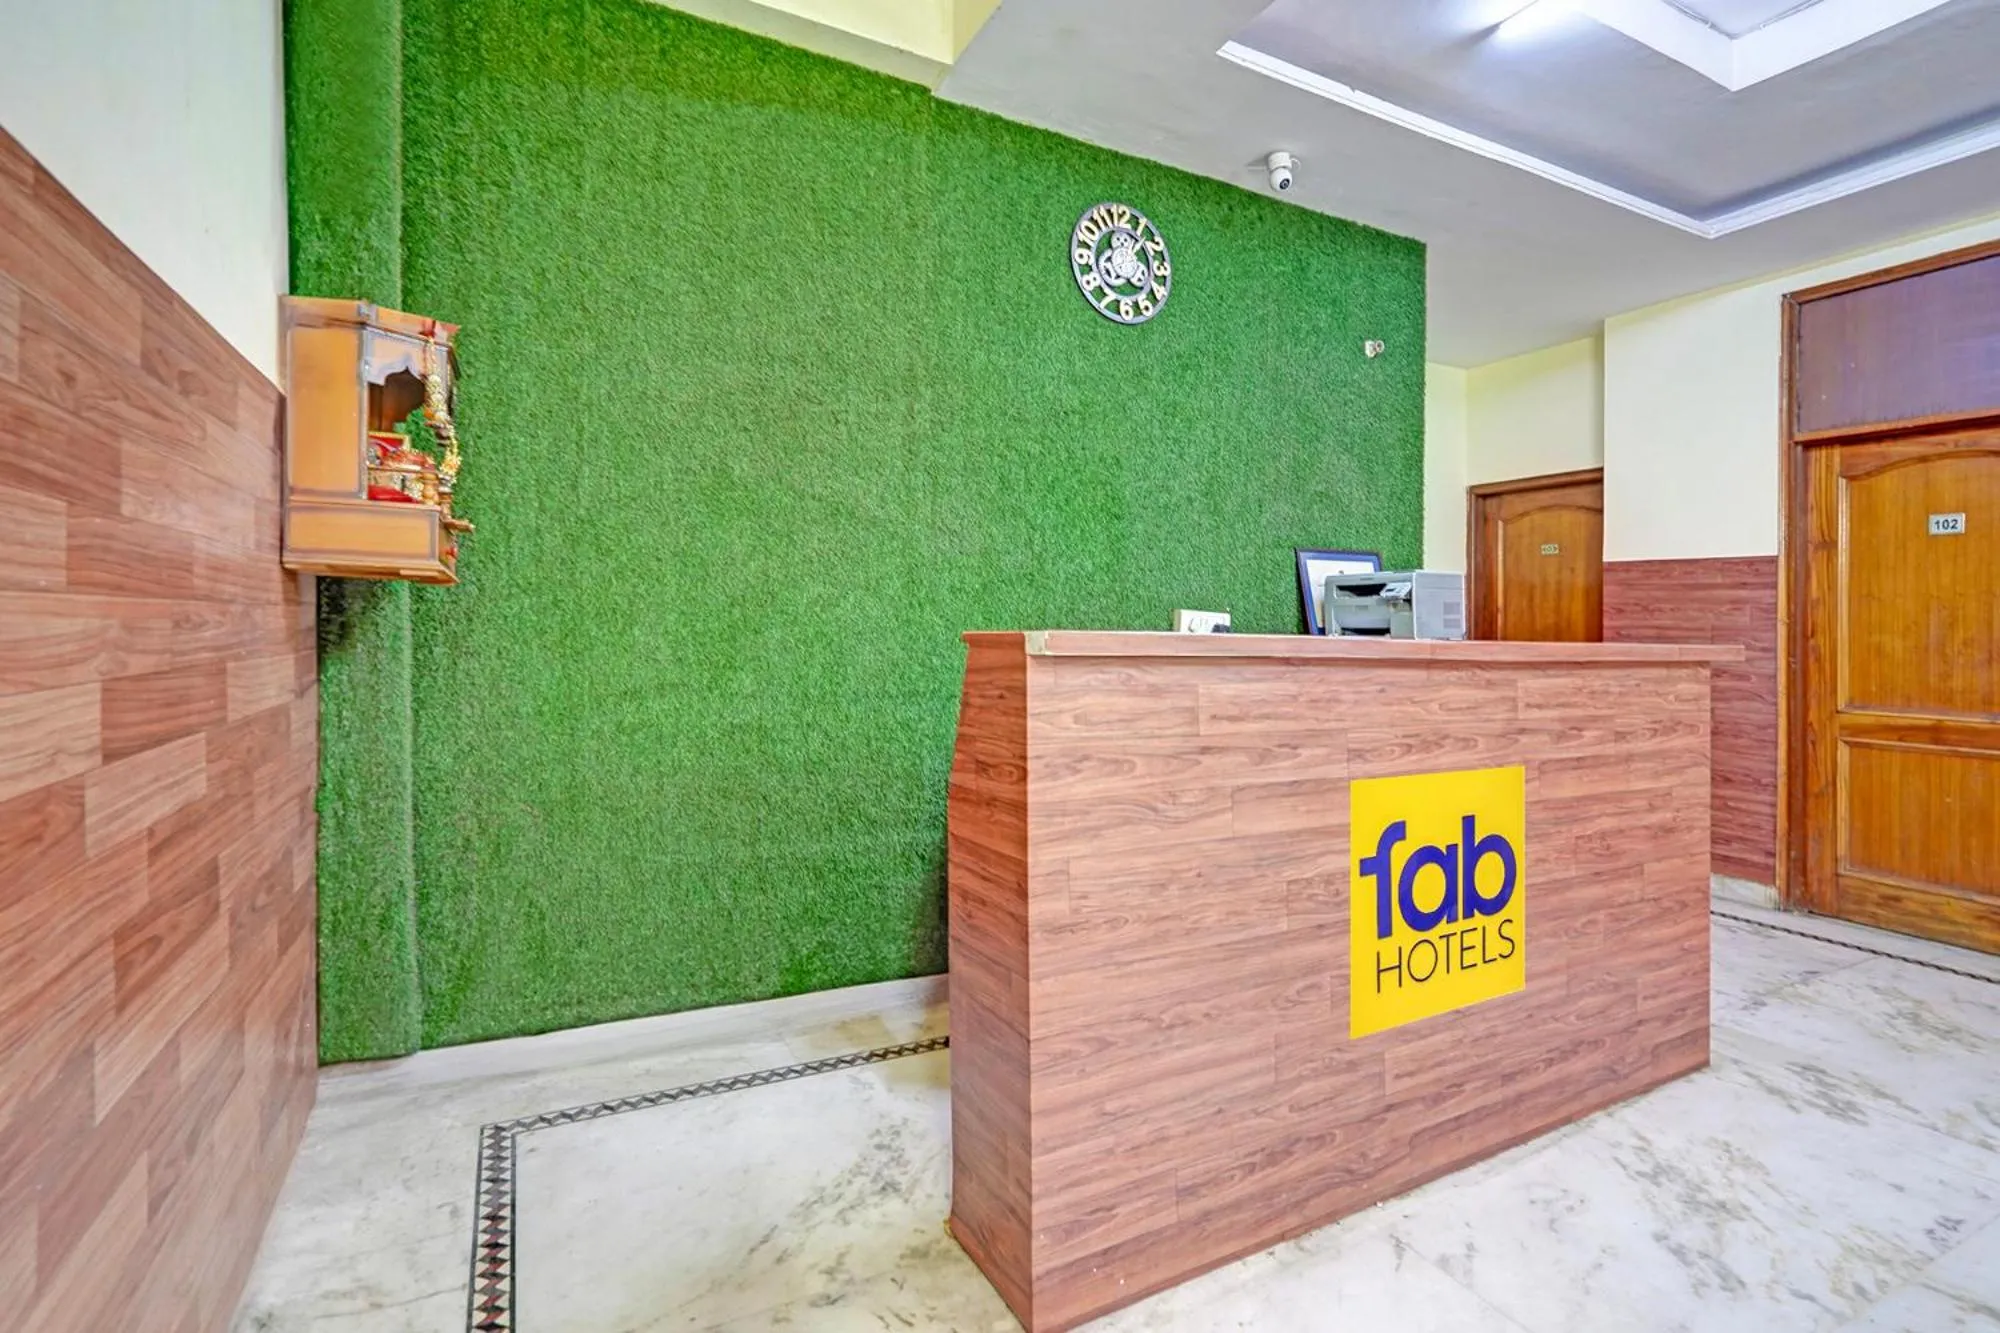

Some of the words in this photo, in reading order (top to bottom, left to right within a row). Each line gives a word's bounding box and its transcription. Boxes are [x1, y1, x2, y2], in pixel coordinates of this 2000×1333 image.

[1092, 204, 1113, 231] 11
[1110, 203, 1132, 230] 12
[1136, 217, 1148, 236] 1
[1077, 220, 1100, 248] 10
[1144, 235, 1165, 256] 2
[1074, 247, 1093, 266] 9
[1152, 260, 1172, 277] 3
[1081, 271, 1101, 292] 8
[1150, 280, 1168, 301] 4
[1100, 287, 1117, 309] 7
[1120, 298, 1134, 321] 6
[1934, 518, 1959, 531] 102
[1359, 814, 1517, 940] fab
[1376, 918, 1516, 994] HOTELS
